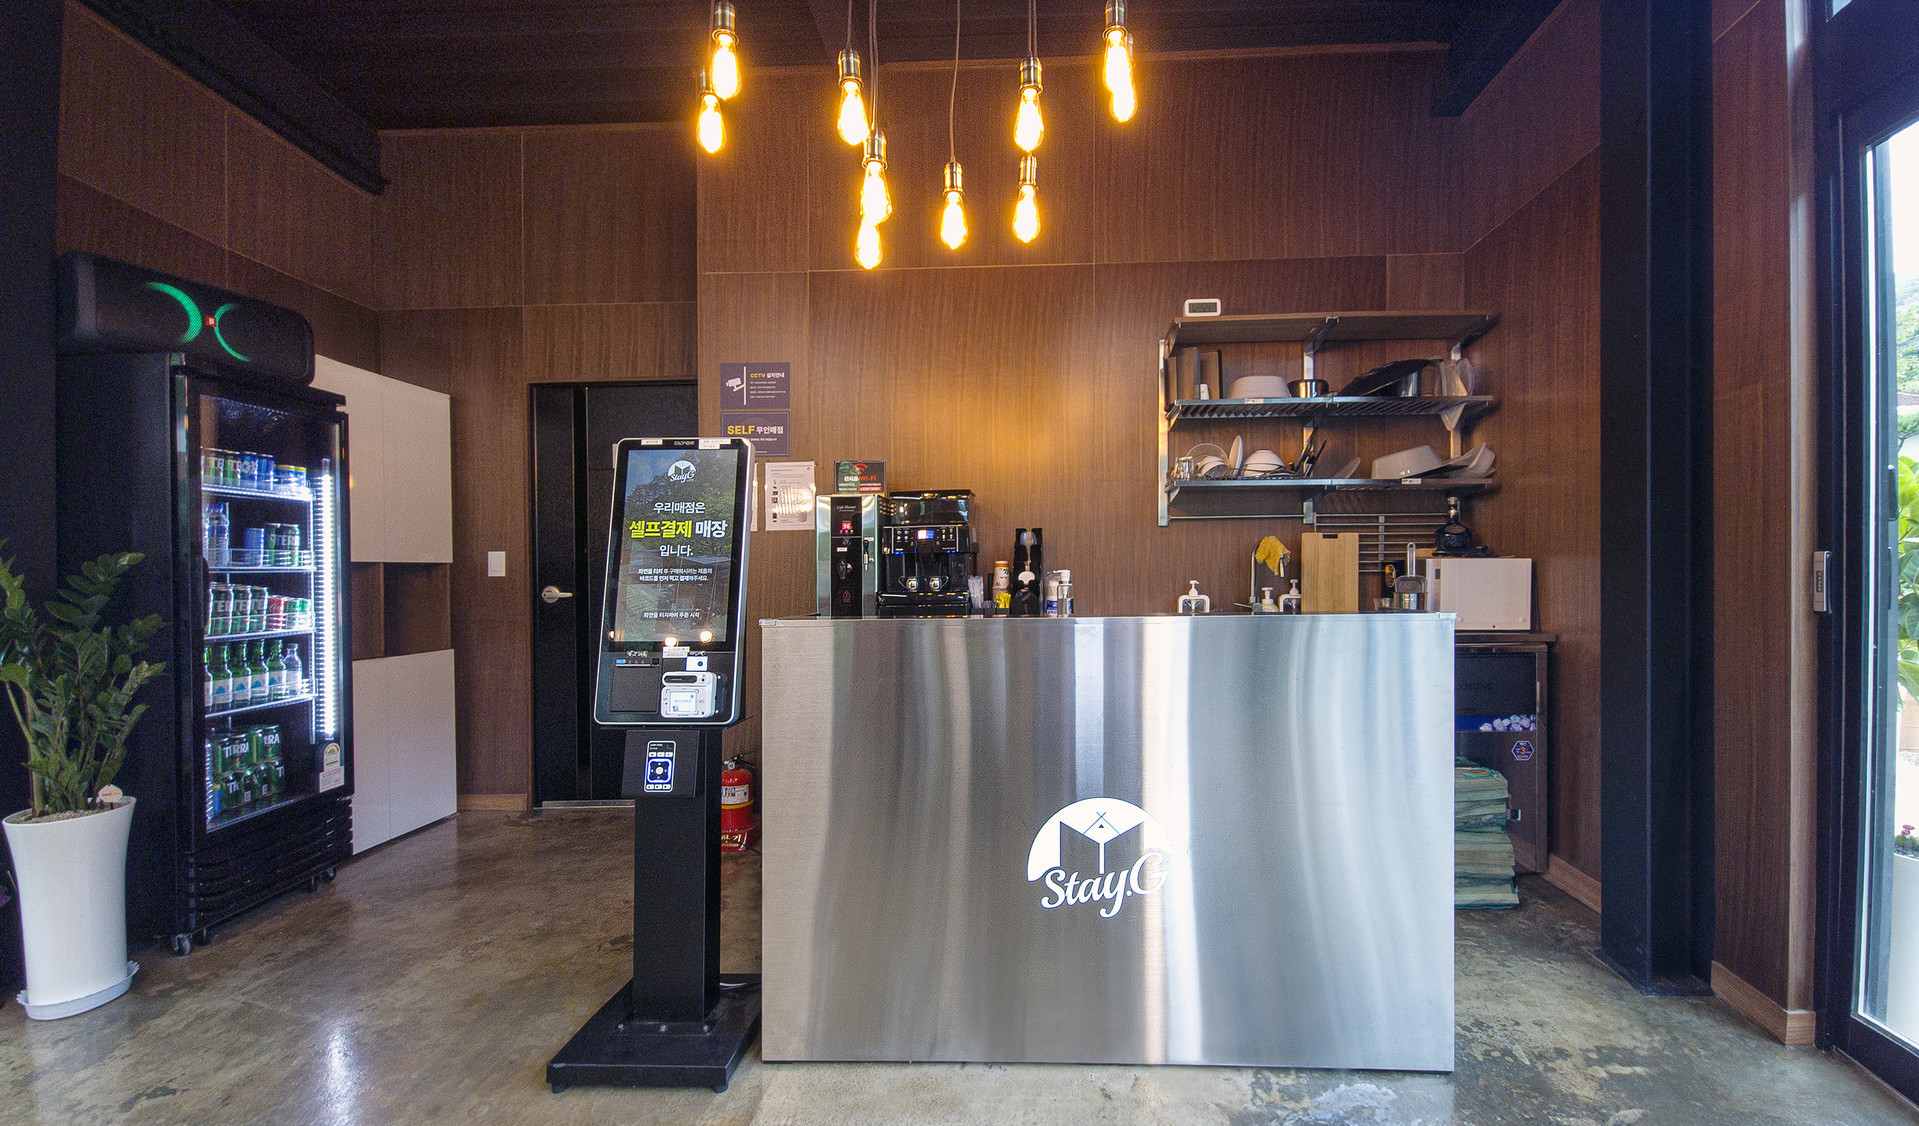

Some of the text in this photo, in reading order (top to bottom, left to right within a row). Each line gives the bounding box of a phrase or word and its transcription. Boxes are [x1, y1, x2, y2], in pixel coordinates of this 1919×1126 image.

[727, 425, 784, 435] SELF 무인매점
[653, 501, 706, 514] 우리매점은
[628, 519, 728, 539] 셀프결제 매장
[659, 544, 694, 557] 입니다.
[1040, 848, 1169, 919] Stay.G
